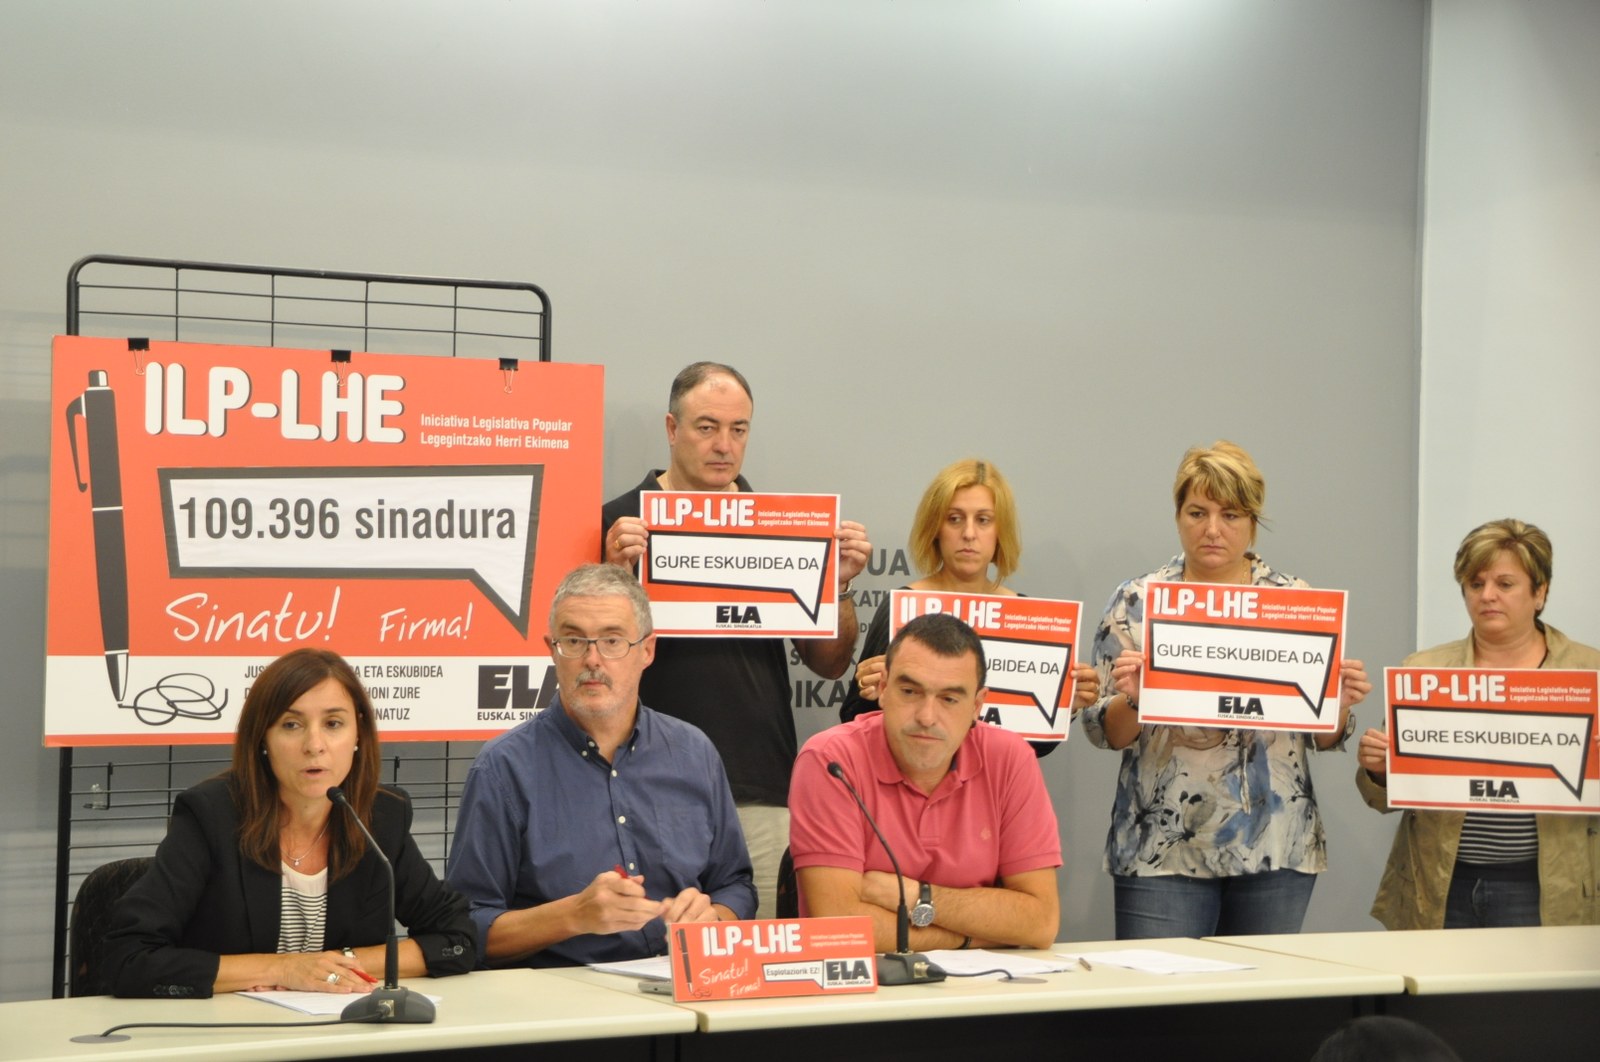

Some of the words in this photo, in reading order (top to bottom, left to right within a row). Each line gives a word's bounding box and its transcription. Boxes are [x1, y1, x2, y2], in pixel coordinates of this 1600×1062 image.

[145, 362, 406, 443] ILP-LHE
[420, 414, 470, 428] Iniciativa
[472, 416, 530, 431] Legislativa
[532, 418, 572, 432] Popular
[420, 432, 492, 448] Legegintzako
[496, 435, 522, 447] Herri
[525, 436, 570, 449] Ekimena
[178, 497, 340, 540] 109.396
[355, 498, 516, 540] sinadura
[651, 497, 755, 526] ILP-LHE
[655, 556, 700, 569] GURE
[704, 556, 794, 570] ESKUBIDEA
[798, 558, 819, 570] DA
[1153, 587, 1259, 619] ILP-LHE
[165, 586, 341, 643] Sinatu!
[380, 602, 474, 642] Firma!
[716, 606, 762, 624] ELA
[1156, 643, 1202, 658] GURE
[1206, 646, 1299, 663] ESKUBIDEA
[1302, 652, 1324, 664] DA
[364, 666, 384, 678] ETA
[386, 666, 444, 678] ESKUBIDEA
[1040, 662, 1060, 675] DA
[393, 686, 420, 698] ZURE
[478, 664, 558, 710] ELA
[1395, 673, 1506, 702] ILP-LHE
[374, 708, 410, 720] NATUZ
[477, 712, 516, 720] EUSKAL
[1218, 696, 1264, 716] ELA
[1402, 729, 1449, 743] GURE
[1453, 730, 1552, 746] ESKUBIDEA
[1557, 733, 1580, 746] DA
[1470, 780, 1519, 798] ELA
[702, 924, 802, 957] ILP-LHE
[699, 958, 748, 985] Sinatu!
[826, 960, 870, 980] ELA
[730, 978, 761, 998] Firma!
